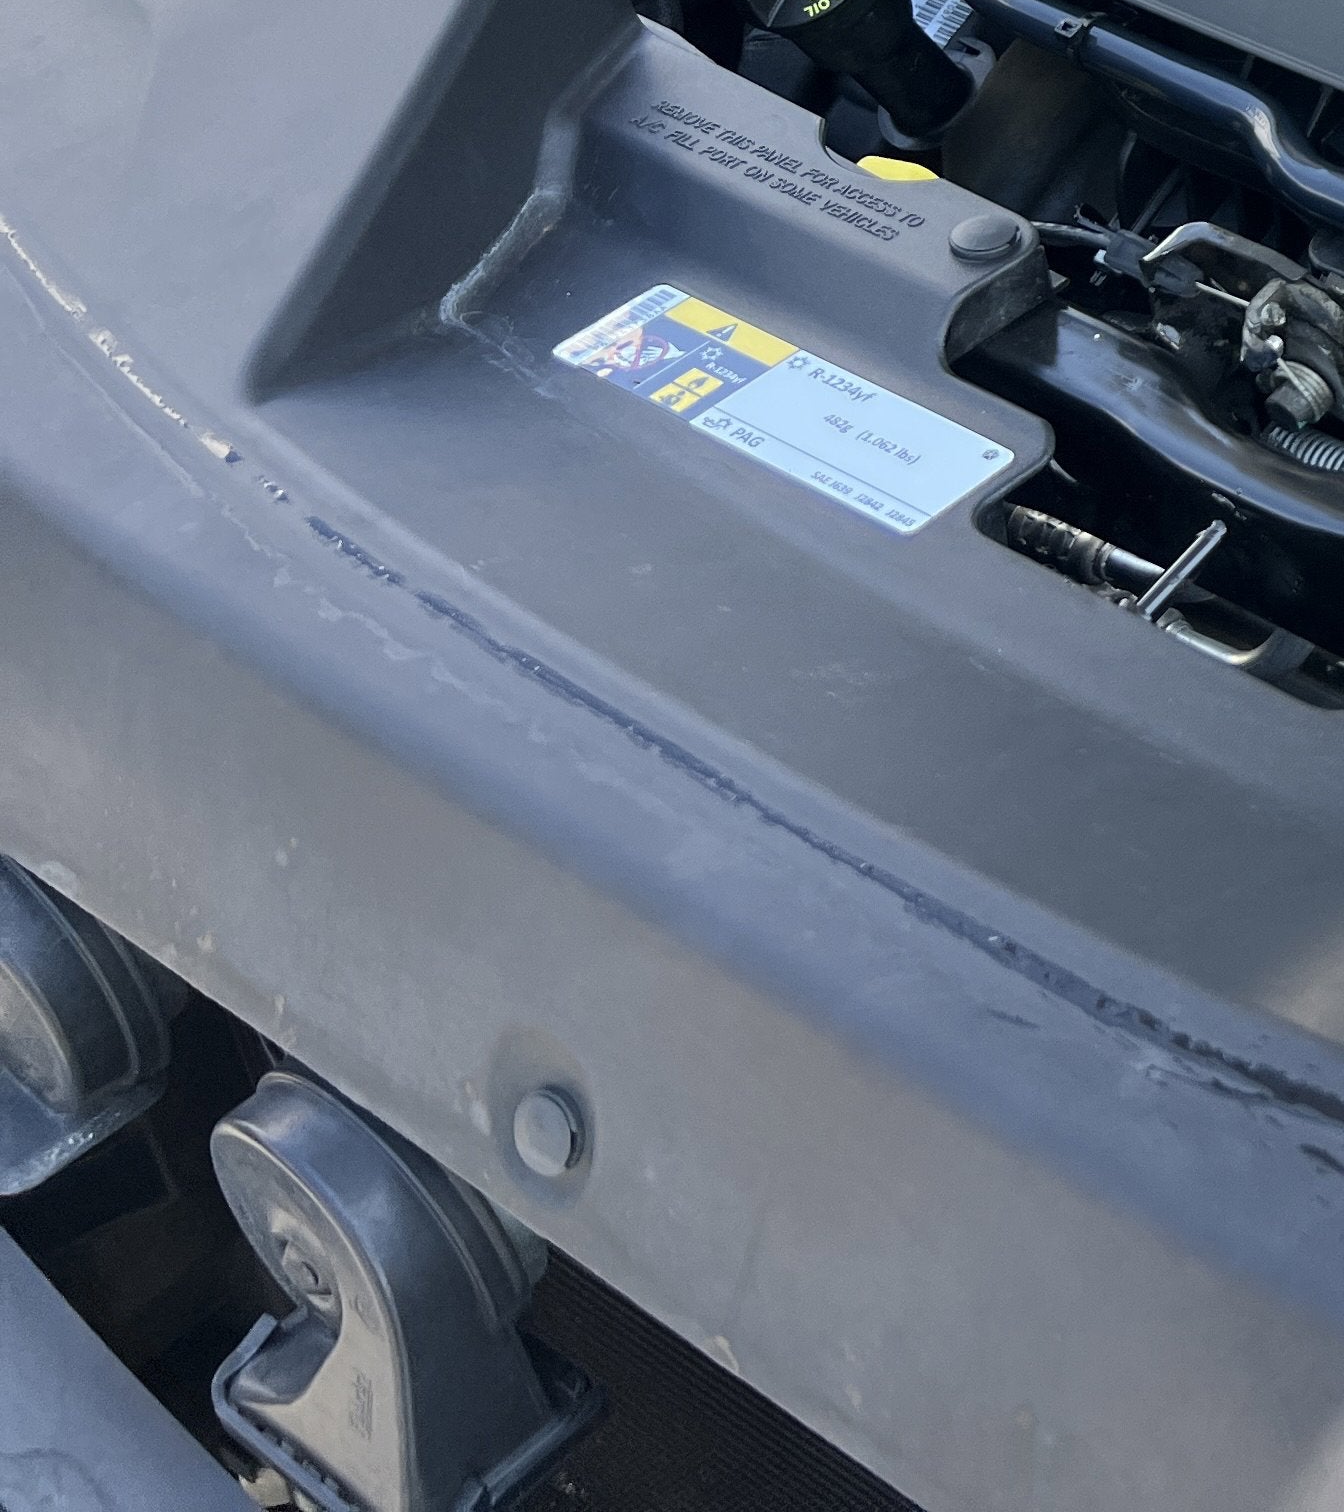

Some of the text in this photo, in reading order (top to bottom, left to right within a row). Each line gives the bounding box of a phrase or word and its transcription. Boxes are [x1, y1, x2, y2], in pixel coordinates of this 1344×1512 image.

[630, 114, 900, 241] A/C FILL PORT ON SOME VEHICLES
[652, 100, 926, 228] REMOVE THIS PANEL FOR ACCESS TO
[808, 367, 878, 402] R-1234yf
[729, 427, 765, 448] PAG
[824, 414, 922, 465] 482g (1.062 lbs)
[810, 470, 832, 485] SAE
